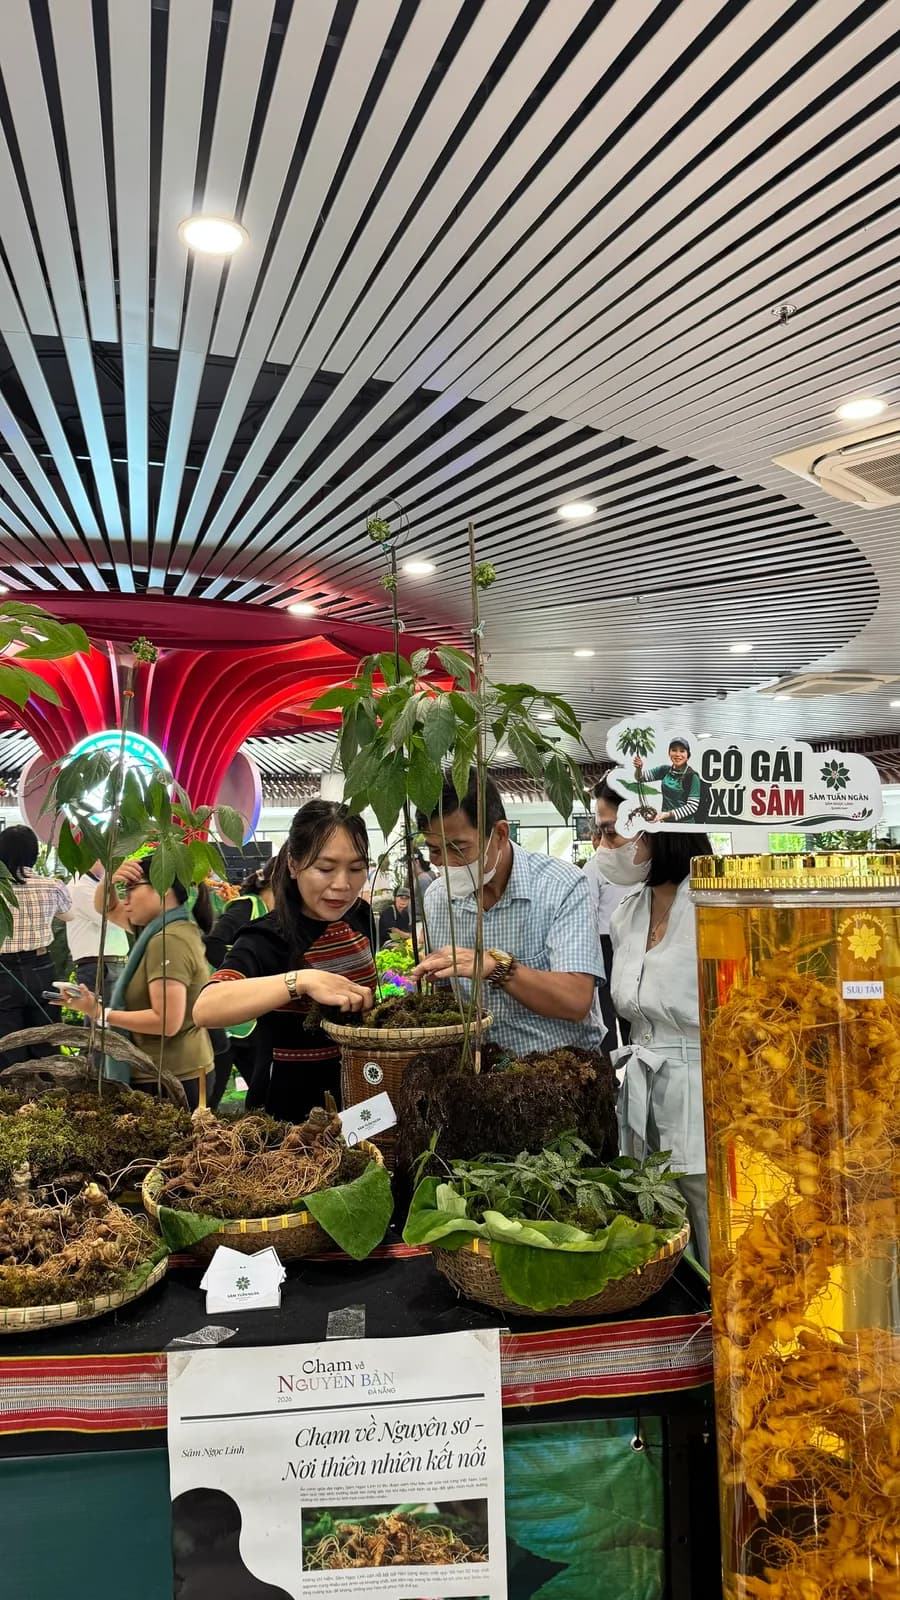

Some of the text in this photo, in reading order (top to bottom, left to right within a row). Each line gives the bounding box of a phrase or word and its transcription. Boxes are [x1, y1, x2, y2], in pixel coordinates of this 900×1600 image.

[701, 745, 803, 783] CÔ GÁI
[710, 784, 804, 816] XỨ SÂM
[277, 1370, 395, 1393] NGUYÊN BẢN
[302, 1359, 352, 1375] Chạm
[295, 1427, 350, 1448] Chạm
[355, 1415, 377, 1441] về
[377, 1418, 447, 1444] Nguyên
[450, 1417, 472, 1434] sơ
[182, 1445, 244, 1457] Sâm Ngọc Linh
[282, 1438, 487, 1480] Nơi thiên nhiên kết nối
